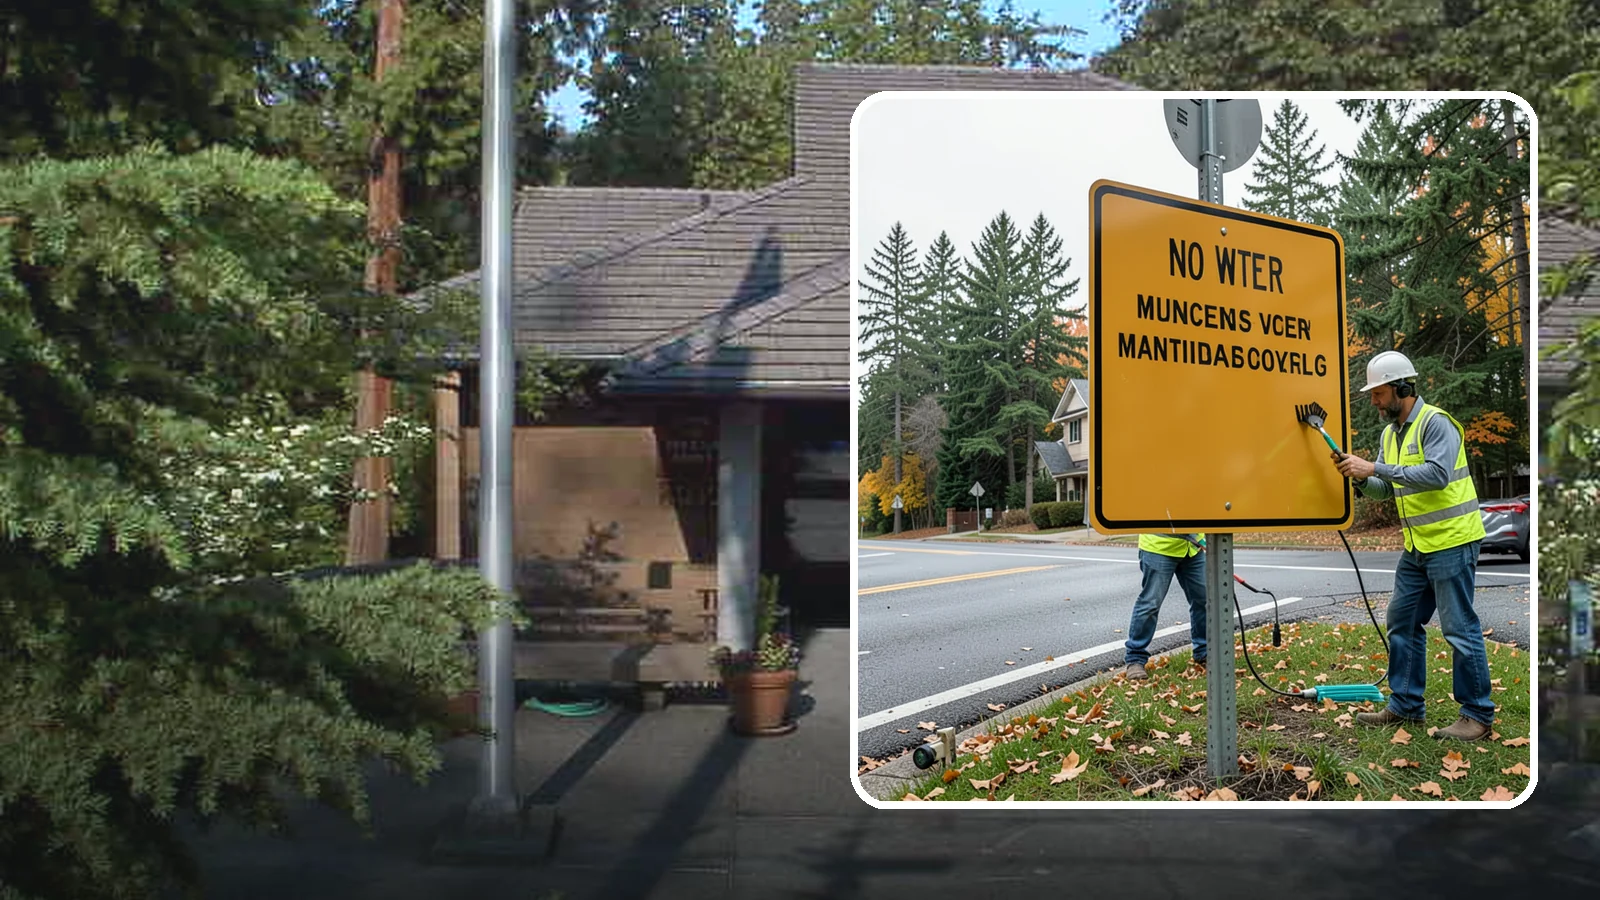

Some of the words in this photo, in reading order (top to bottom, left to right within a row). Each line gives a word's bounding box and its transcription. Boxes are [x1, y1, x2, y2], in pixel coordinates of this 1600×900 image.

[1169, 237, 1204, 281] NO
[1215, 245, 1284, 294] WTER
[1137, 294, 1251, 333] MUNCENS
